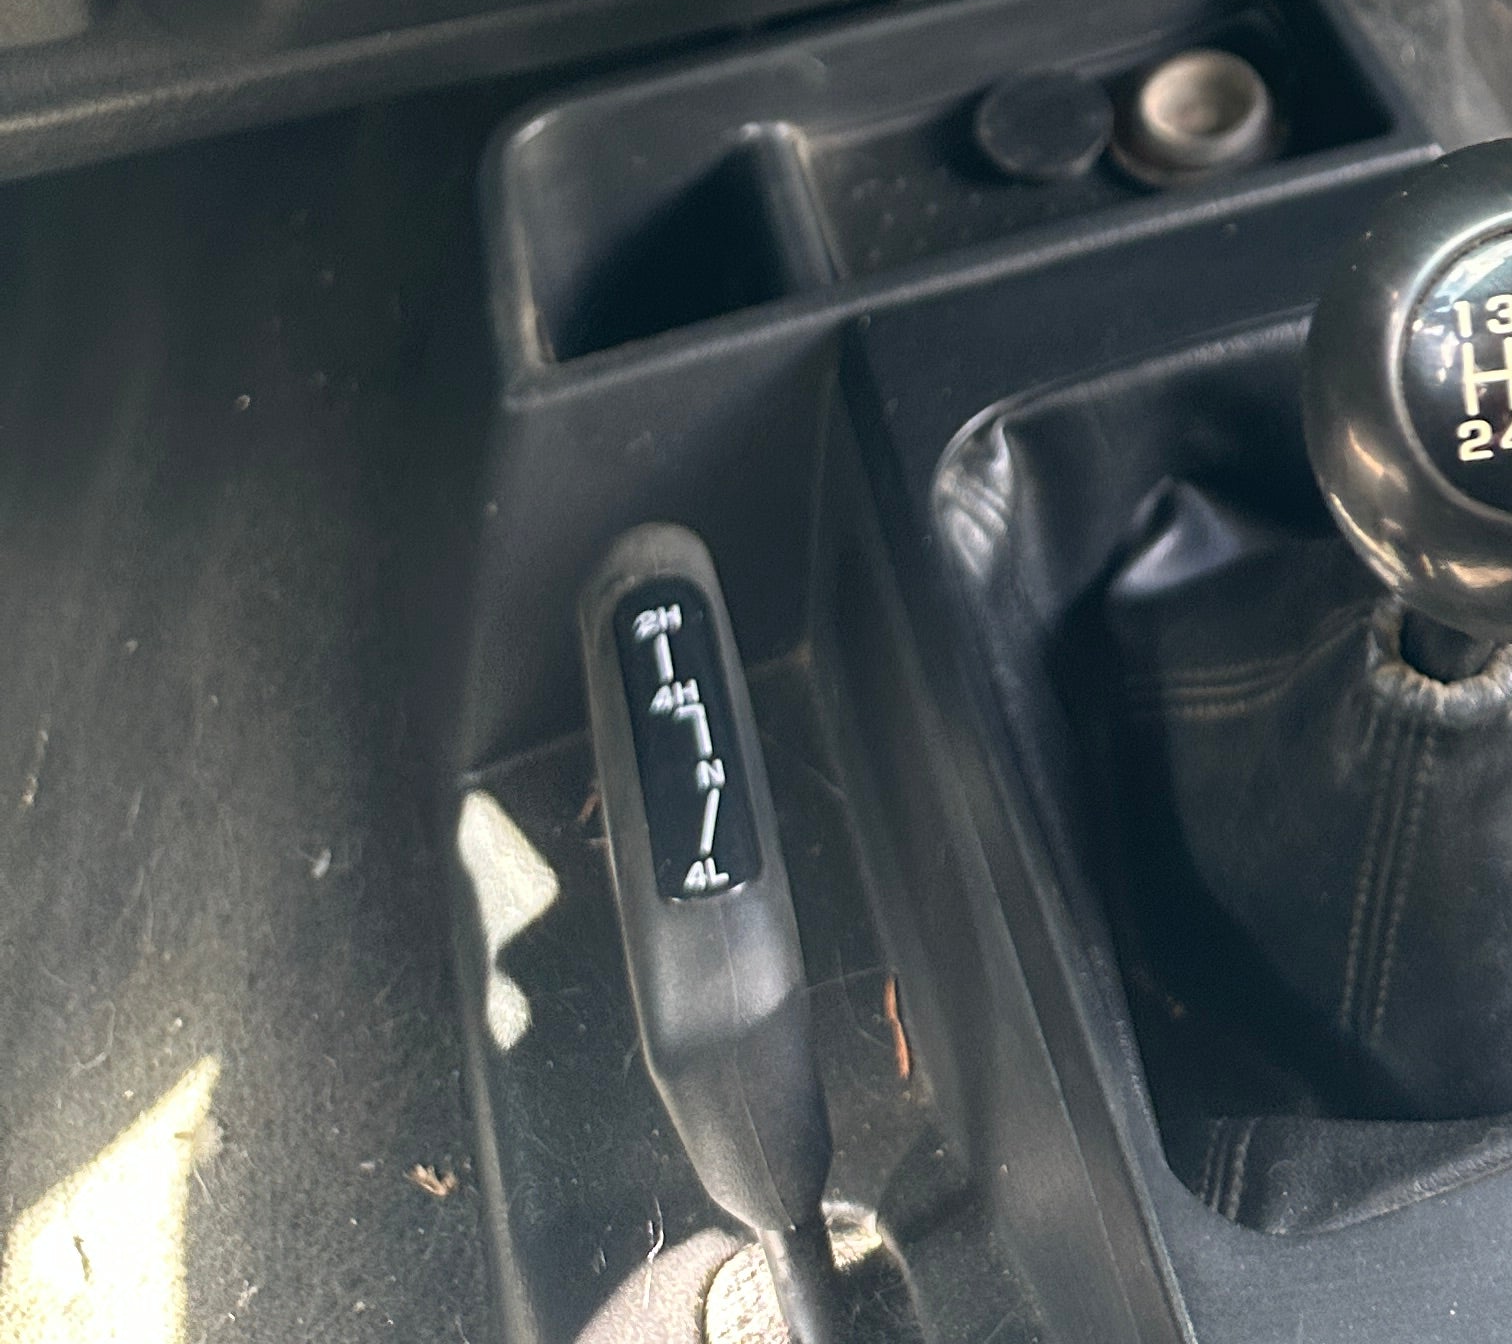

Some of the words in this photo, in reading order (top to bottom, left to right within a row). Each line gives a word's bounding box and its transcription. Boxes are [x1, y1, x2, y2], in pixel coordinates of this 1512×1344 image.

[650, 678, 699, 712] 4H
[696, 758, 725, 790] N
[683, 857, 729, 892] 4L
